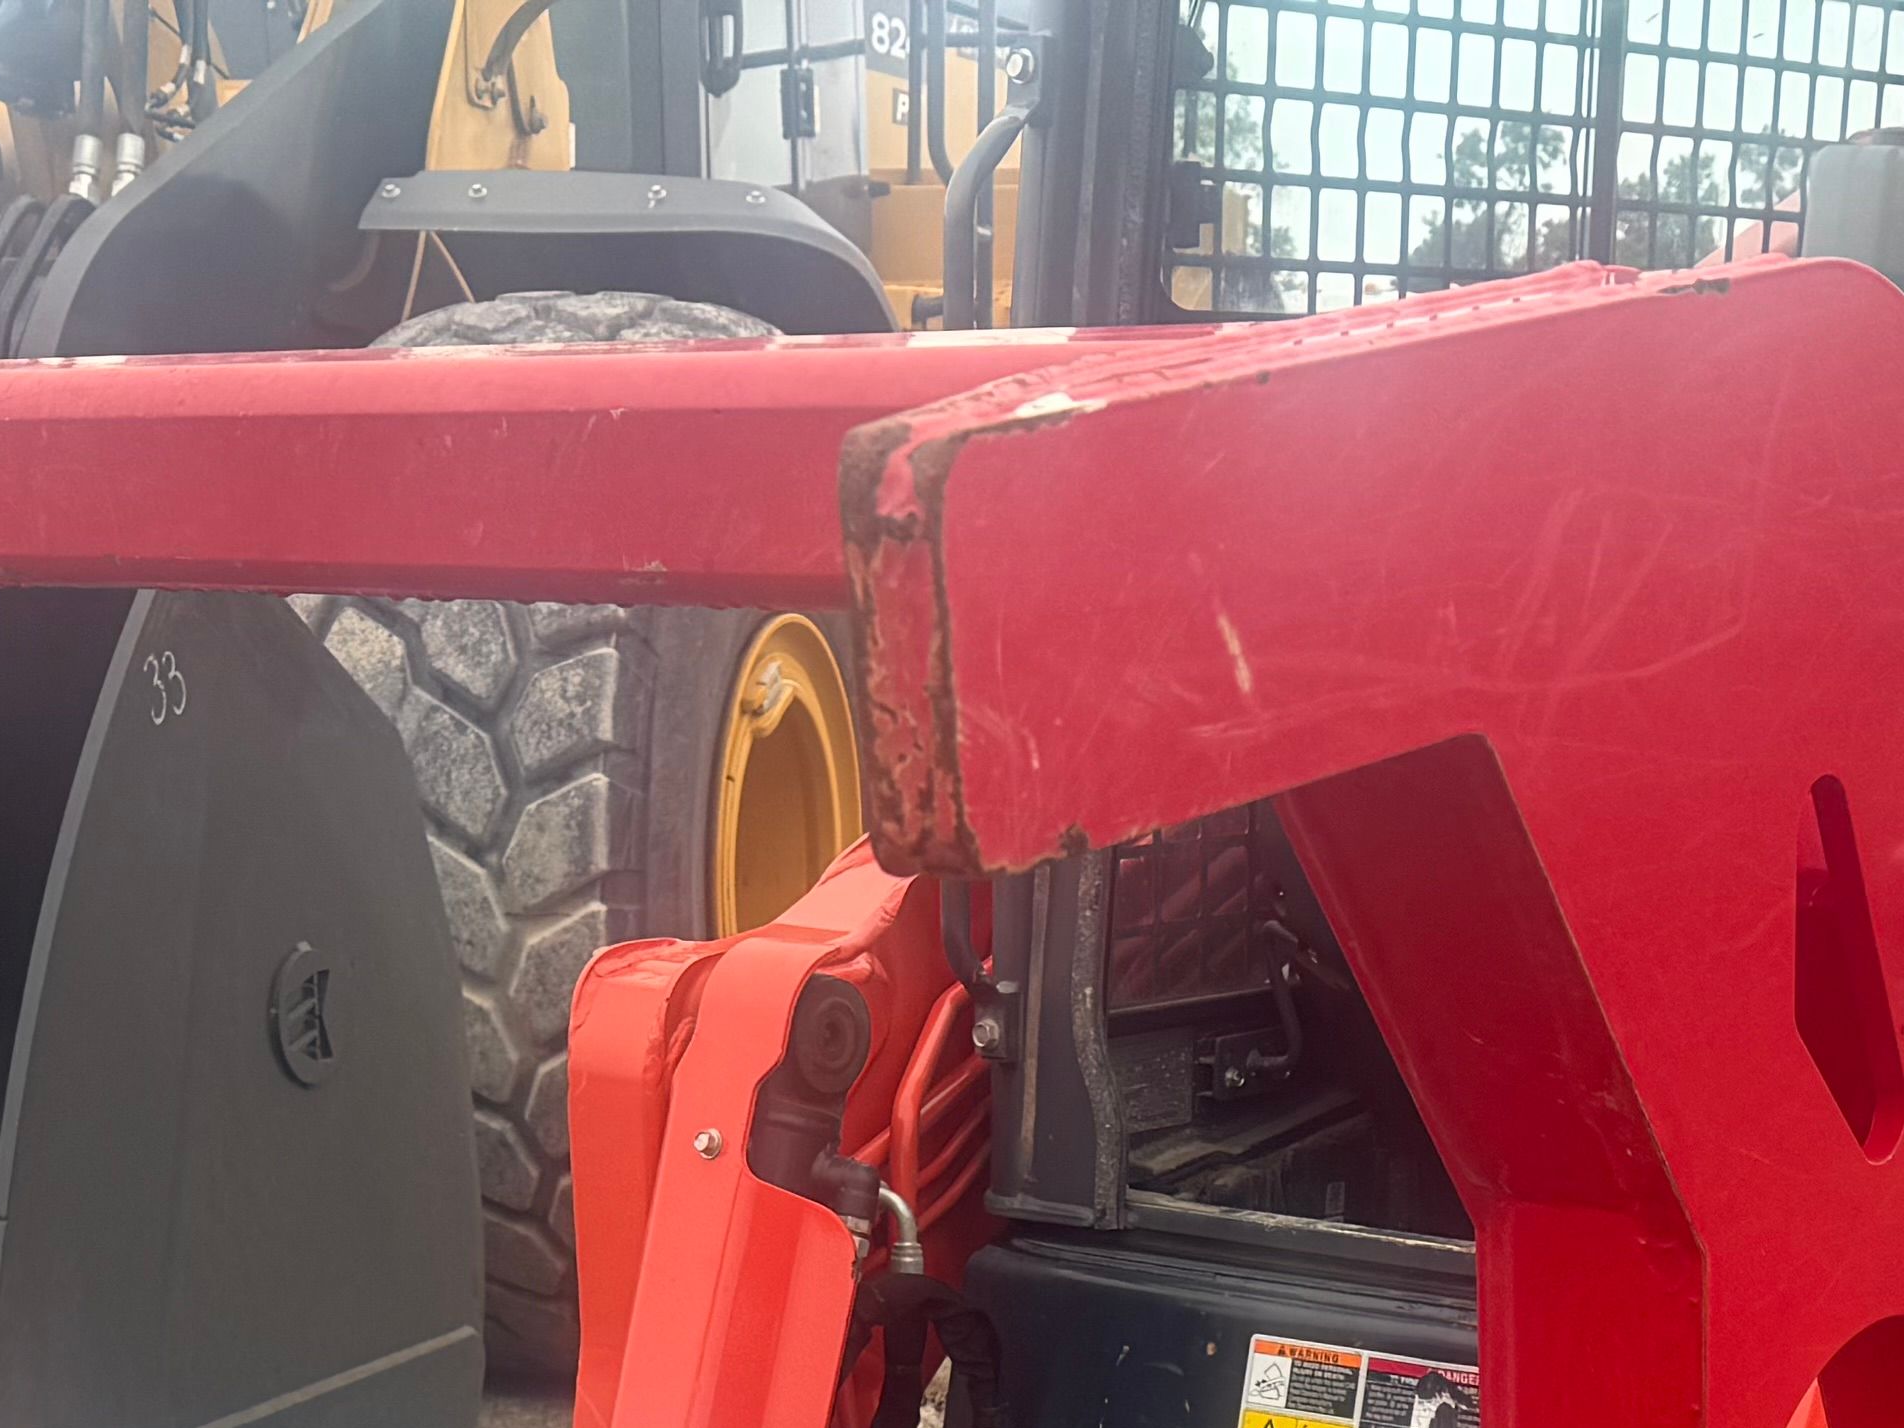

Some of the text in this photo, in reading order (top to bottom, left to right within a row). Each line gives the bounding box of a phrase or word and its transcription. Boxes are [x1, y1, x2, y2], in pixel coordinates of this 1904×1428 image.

[871, 12, 909, 60] 82
[143, 651, 187, 725] 33
[1289, 1347, 1339, 1364] WARNING
